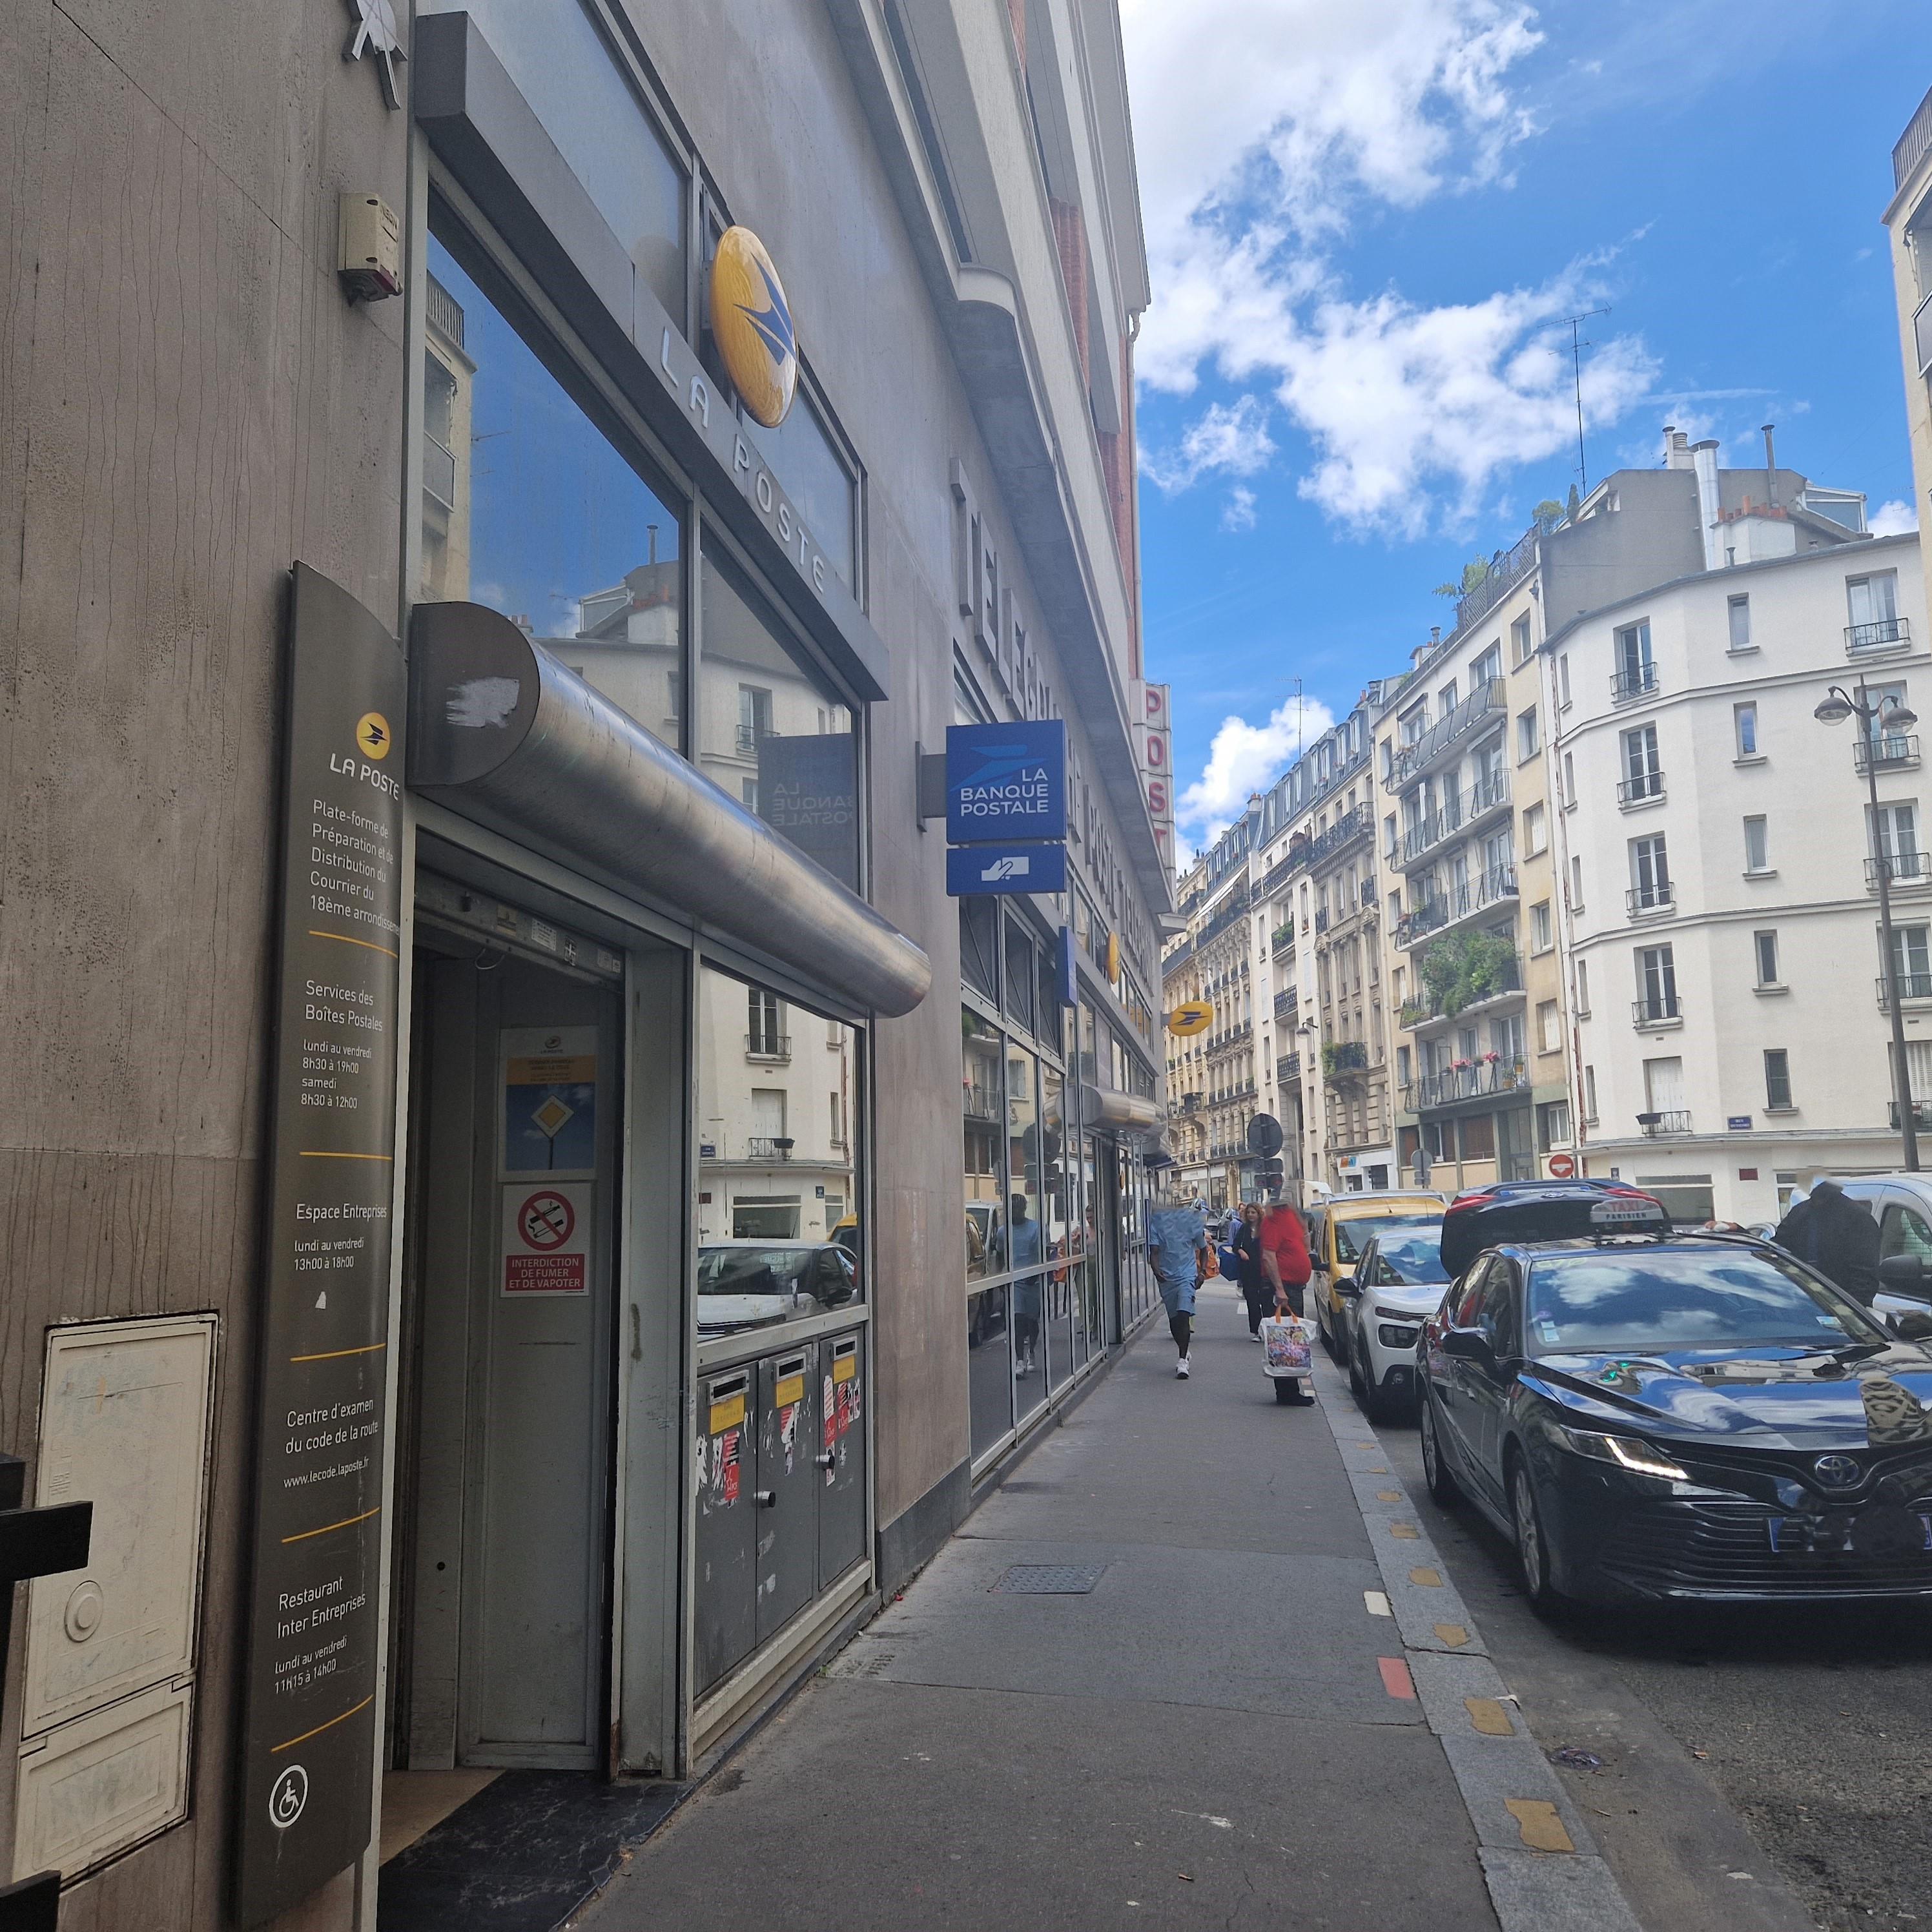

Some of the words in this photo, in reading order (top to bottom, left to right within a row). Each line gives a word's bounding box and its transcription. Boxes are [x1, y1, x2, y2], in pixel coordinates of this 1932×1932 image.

[661, 327, 709, 428] LA
[733, 434, 825, 595] POSTE
[330, 753, 355, 777] LA
[360, 765, 399, 801] POSTE
[1022, 768, 1048, 782] LA
[960, 784, 1048, 801] BANQUE
[313, 799, 378, 834] Plate-forme
[380, 825, 389, 839] de
[960, 799, 1049, 817] POSTALE
[313, 823, 376, 856] Préparation
[378, 848, 386, 861] et
[387, 850, 393, 865] de
[311, 847, 375, 879] Distribution
[376, 868, 386, 883] du
[310, 871, 361, 896] Courrier
[363, 885, 374, 901] du
[310, 894, 351, 918] 18ème
[305, 980, 356, 1002] Services
[358, 989, 373, 1006] des
[305, 1004, 345, 1025] Boîtes
[348, 1011, 383, 1032] Postales
[303, 1039, 329, 1053] lundi
[331, 1044, 341, 1054] au
[343, 1045, 372, 1059] vendredi
[302, 1057, 327, 1071] 8h30
[329, 1058, 334, 1071] à
[337, 1060, 359, 1074] 19h00
[302, 1077, 336, 1089] samedi
[301, 1094, 325, 1106] 8h30
[327, 1094, 333, 1107] à
[335, 1096, 357, 1109] 12h00
[296, 1203, 340, 1223] Espace
[343, 1203, 387, 1222] Entreprises
[1610, 1200, 1638, 1212] TAXI
[294, 1238, 319, 1253] lundi
[321, 1240, 331, 1251] au
[333, 1237, 364, 1250] vendredi
[294, 1257, 322, 1271] 13h00
[324, 1257, 330, 1269] à
[332, 1255, 355, 1269] 18h00
[511, 1257, 579, 1268] INTERDICTION
[521, 1268, 534, 1278] DE
[536, 1268, 569, 1278] FUMER
[509, 1279, 519, 1288] ET
[522, 1279, 535, 1288] DE
[537, 1277, 581, 1288] VAPOTER
[287, 1408, 328, 1428] Centre
[331, 1399, 374, 1420] d'examen
[285, 1437, 302, 1454] du
[305, 1431, 332, 1451] code
[335, 1428, 347, 1444] de
[350, 1425, 358, 1441] la
[360, 1420, 378, 1437] route
[283, 1456, 369, 1488] www.lecode.laposte.fr
[278, 1576, 343, 1612] Restaurant
[277, 1617, 307, 1639] Inter
[311, 1592, 366, 1629] Entreprises
[274, 1655, 300, 1674] lundi
[302, 1652, 313, 1665] au
[314, 1635, 347, 1660] vendredi
[274, 1672, 303, 1695] 11h15
[305, 1669, 311, 1683] à
[313, 1658, 337, 1680] 14h00
